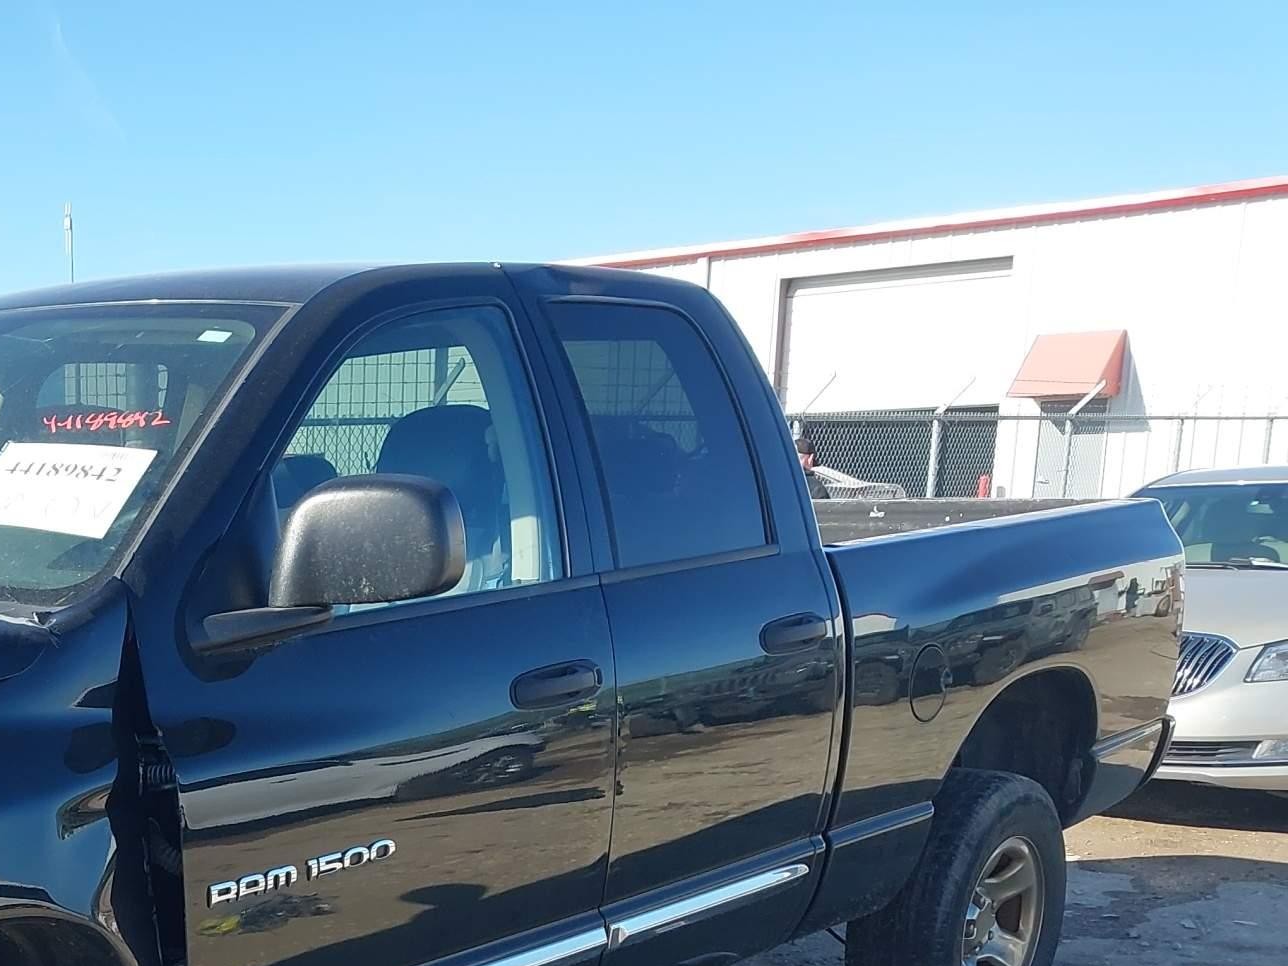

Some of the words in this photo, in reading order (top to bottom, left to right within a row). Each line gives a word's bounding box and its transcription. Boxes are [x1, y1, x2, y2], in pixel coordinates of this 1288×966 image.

[5, 461, 123, 482] 44189842
[207, 864, 298, 908] RAM
[306, 838, 397, 881] 1500
